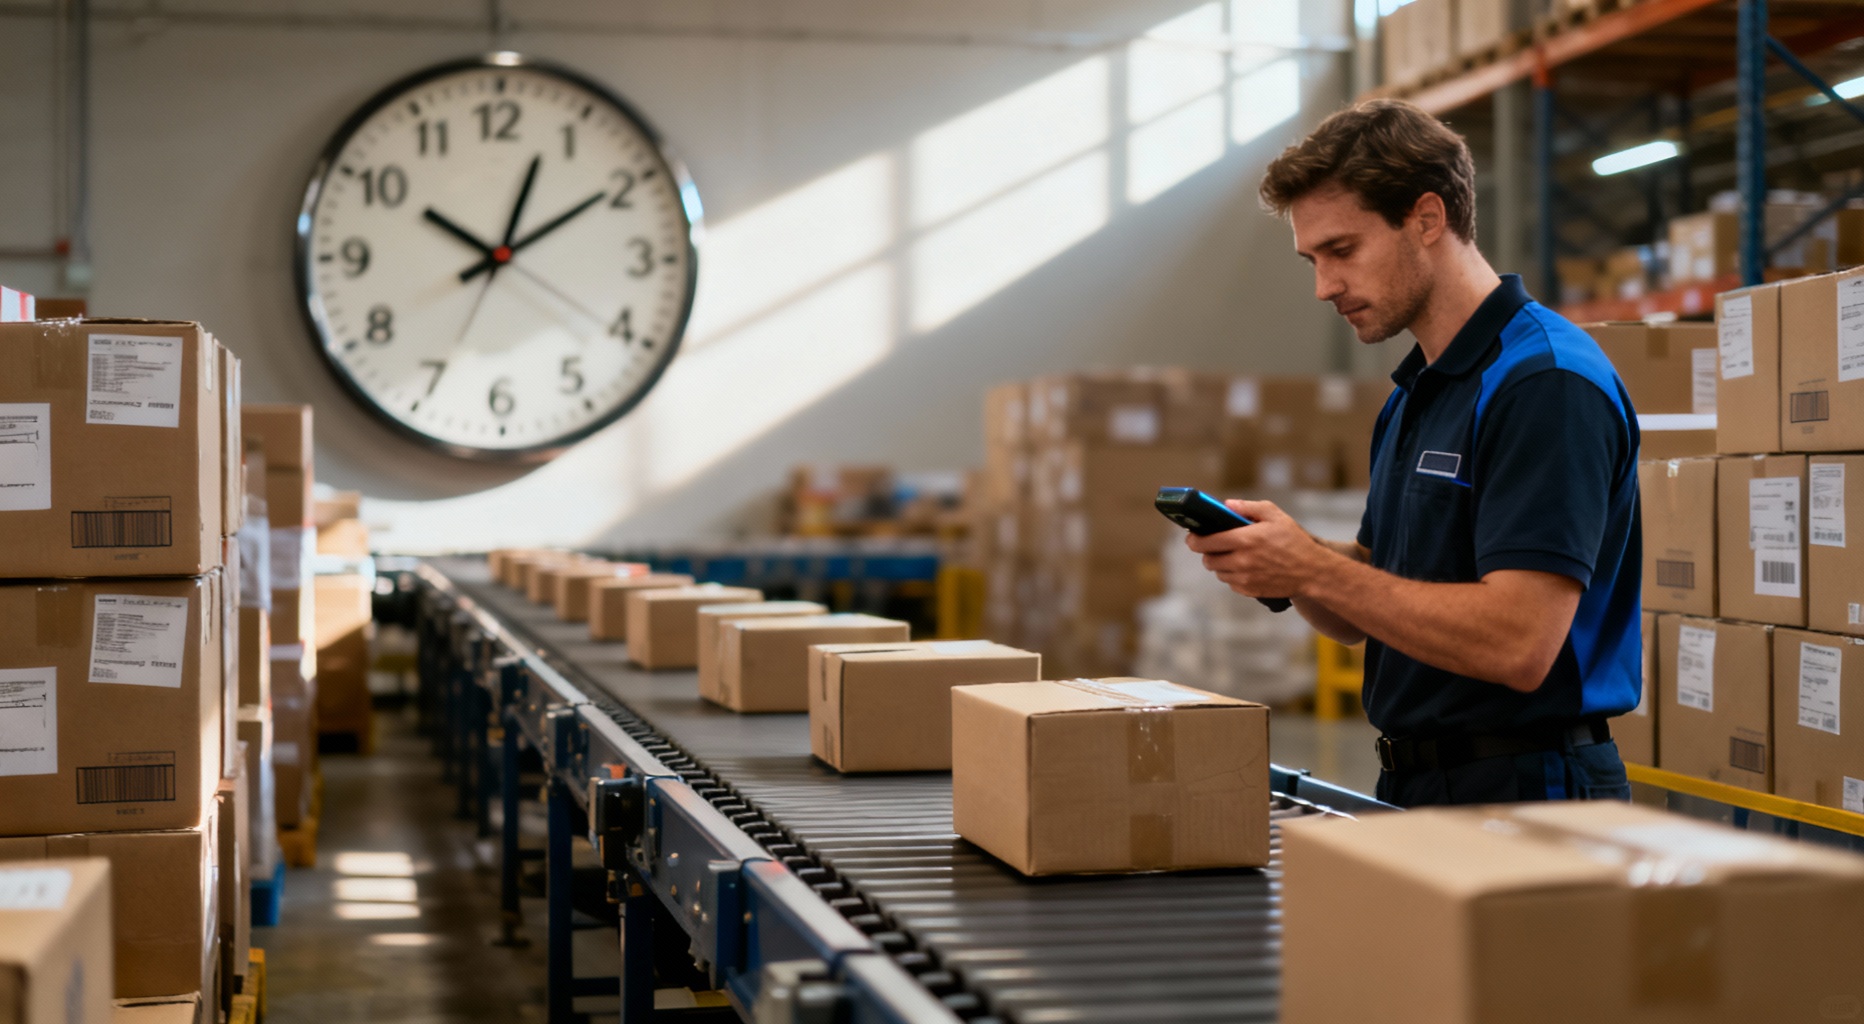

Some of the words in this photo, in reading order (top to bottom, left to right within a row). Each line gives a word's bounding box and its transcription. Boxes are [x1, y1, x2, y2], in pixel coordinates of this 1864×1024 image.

[416, 120, 450, 157] 11
[473, 102, 523, 142] 12
[560, 124, 577, 160] 1
[359, 165, 408, 209] 10
[608, 170, 637, 209] 2
[340, 238, 372, 278] 9
[627, 239, 655, 279] 3
[365, 305, 394, 344] 8
[608, 306, 634, 346] 4
[419, 360, 447, 396] 7
[560, 356, 585, 395] 5
[488, 378, 516, 416] 6
